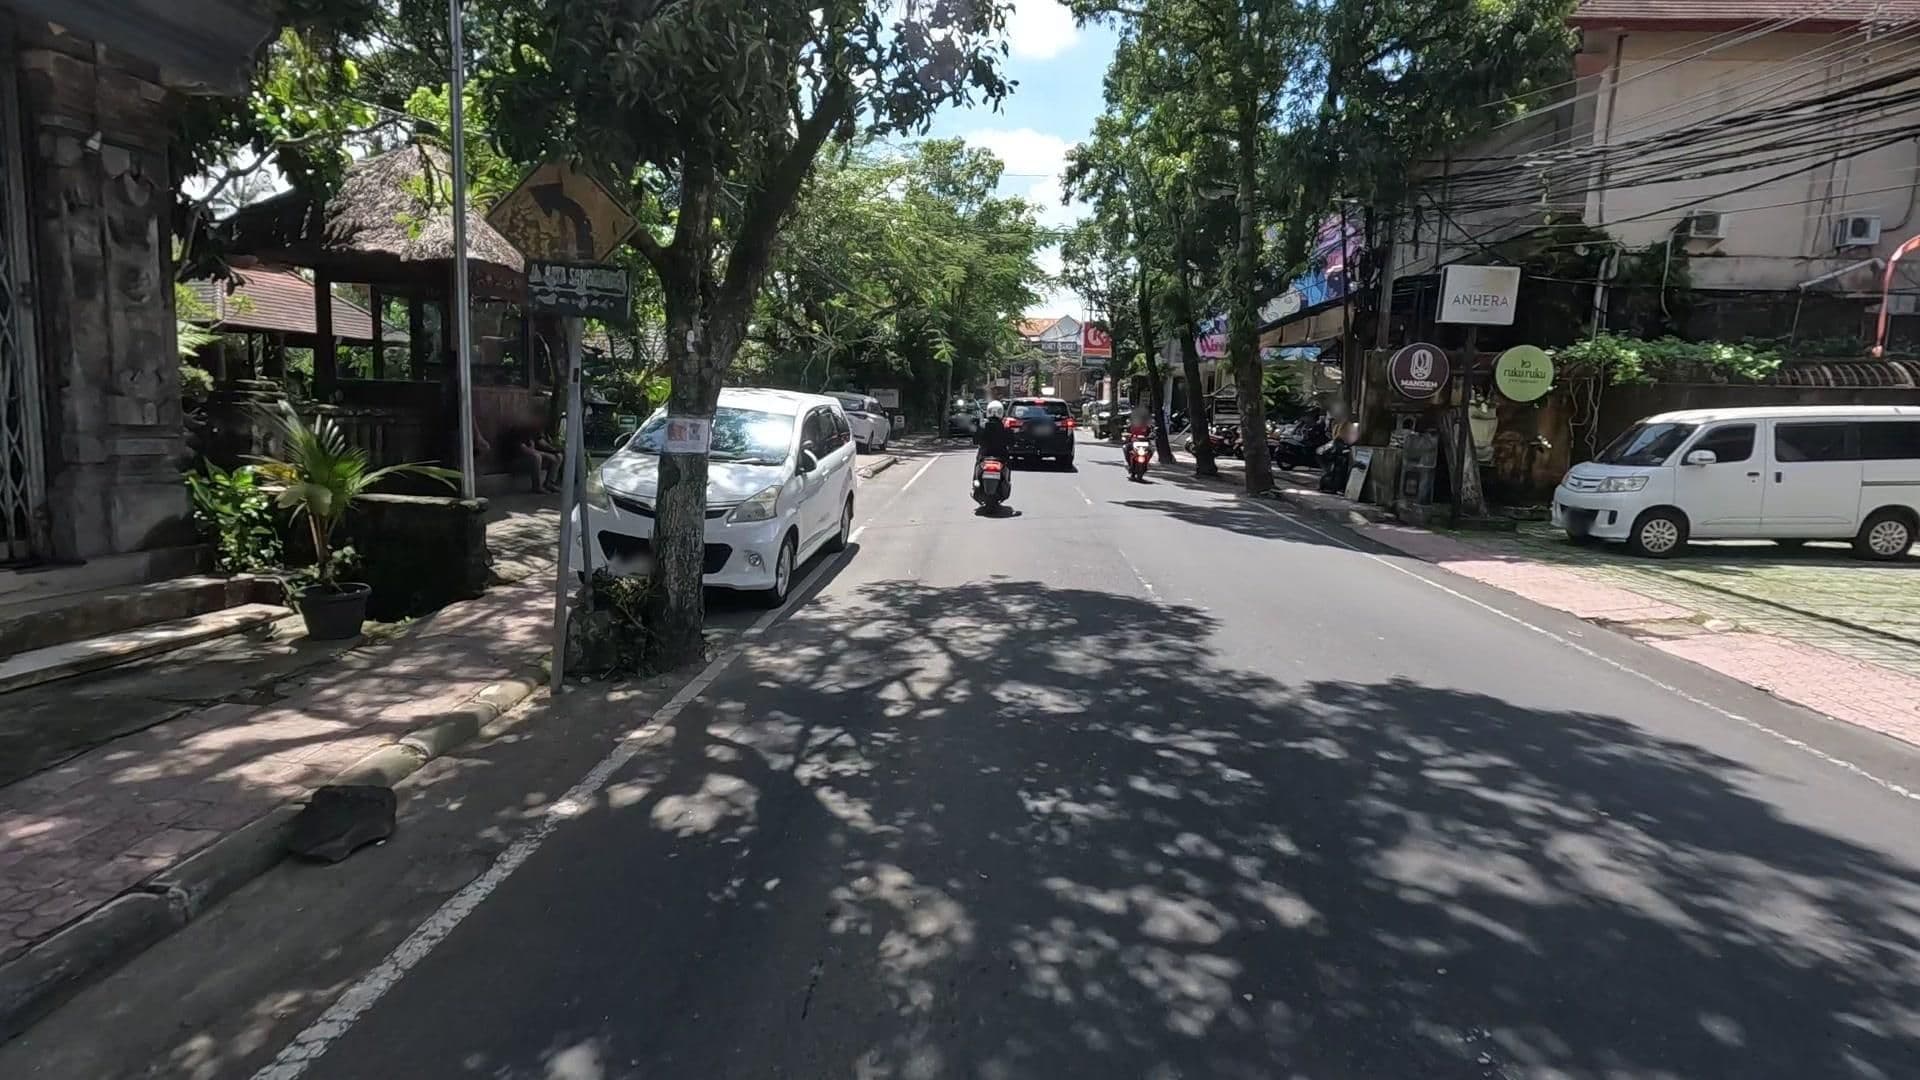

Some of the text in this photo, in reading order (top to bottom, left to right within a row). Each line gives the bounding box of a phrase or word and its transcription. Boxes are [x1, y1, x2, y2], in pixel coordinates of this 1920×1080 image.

[1452, 294, 1509, 307] ANHERA
[1503, 368, 1546, 379] ruku ruku
